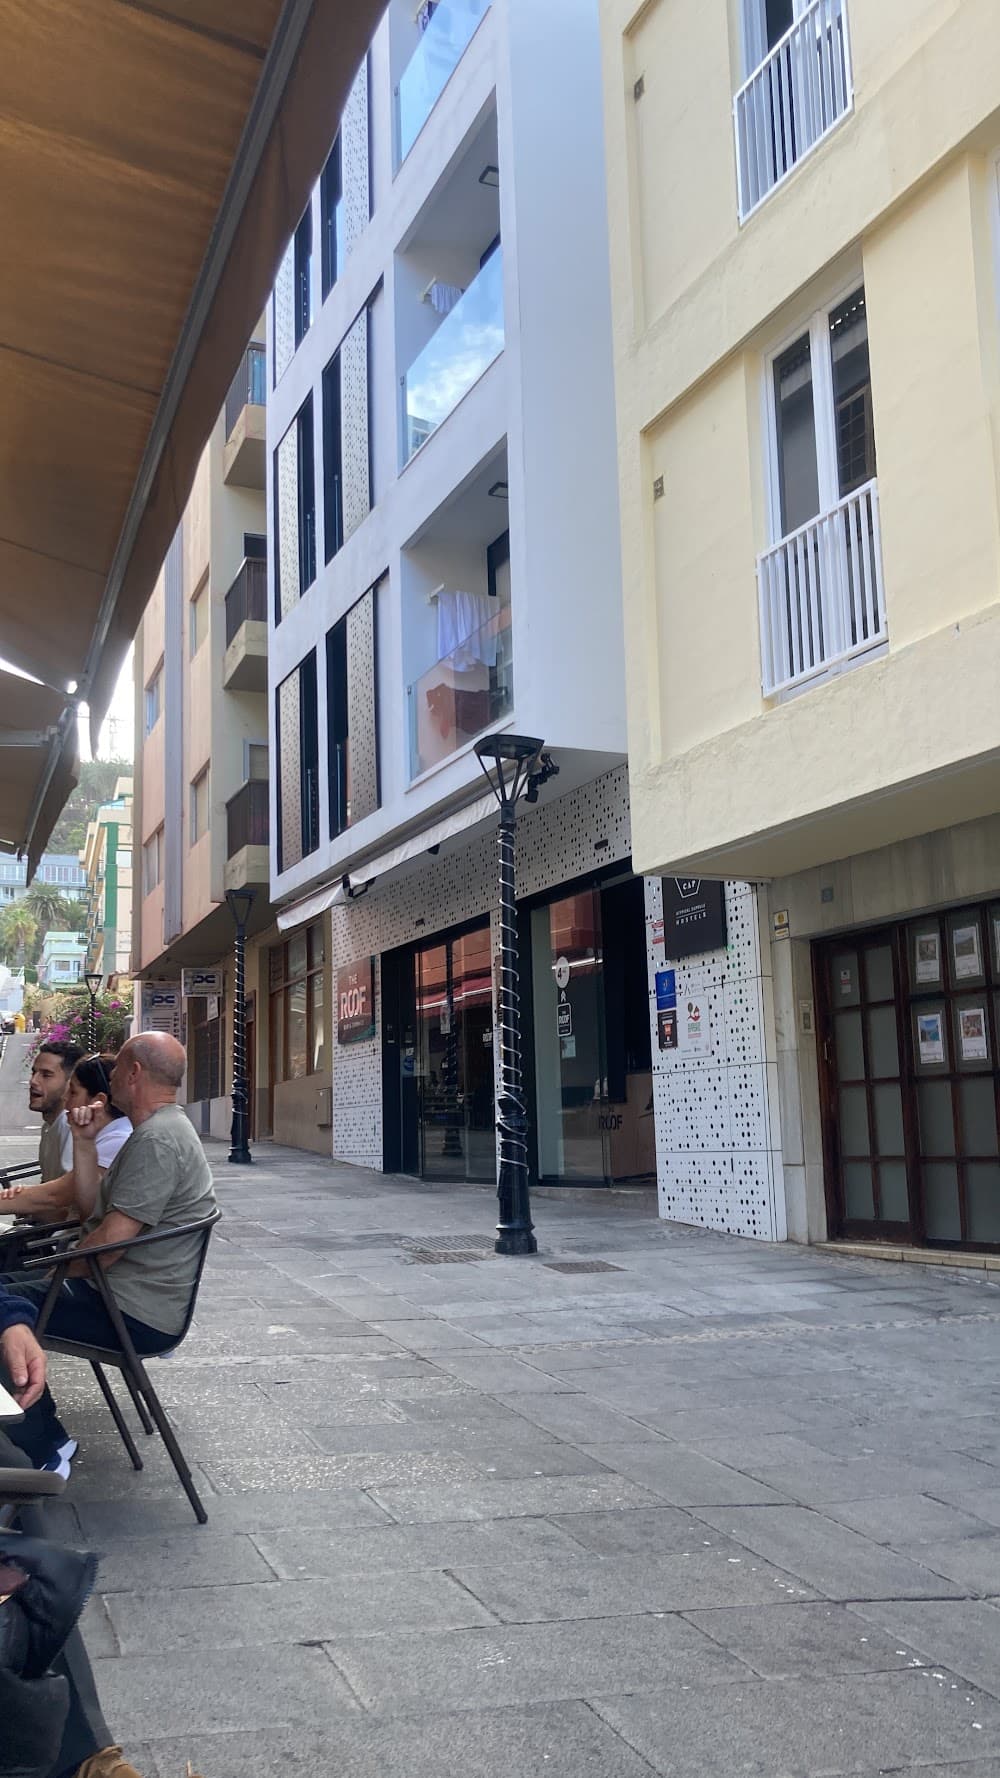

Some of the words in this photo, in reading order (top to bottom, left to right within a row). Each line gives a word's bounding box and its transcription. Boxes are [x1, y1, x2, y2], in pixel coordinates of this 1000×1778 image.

[682, 880, 696, 890] CAP
[676, 912, 707, 926] HOSTELS
[348, 974, 358, 985] THE
[340, 986, 366, 1019] ROOF
[559, 1014, 570, 1025] ROOF
